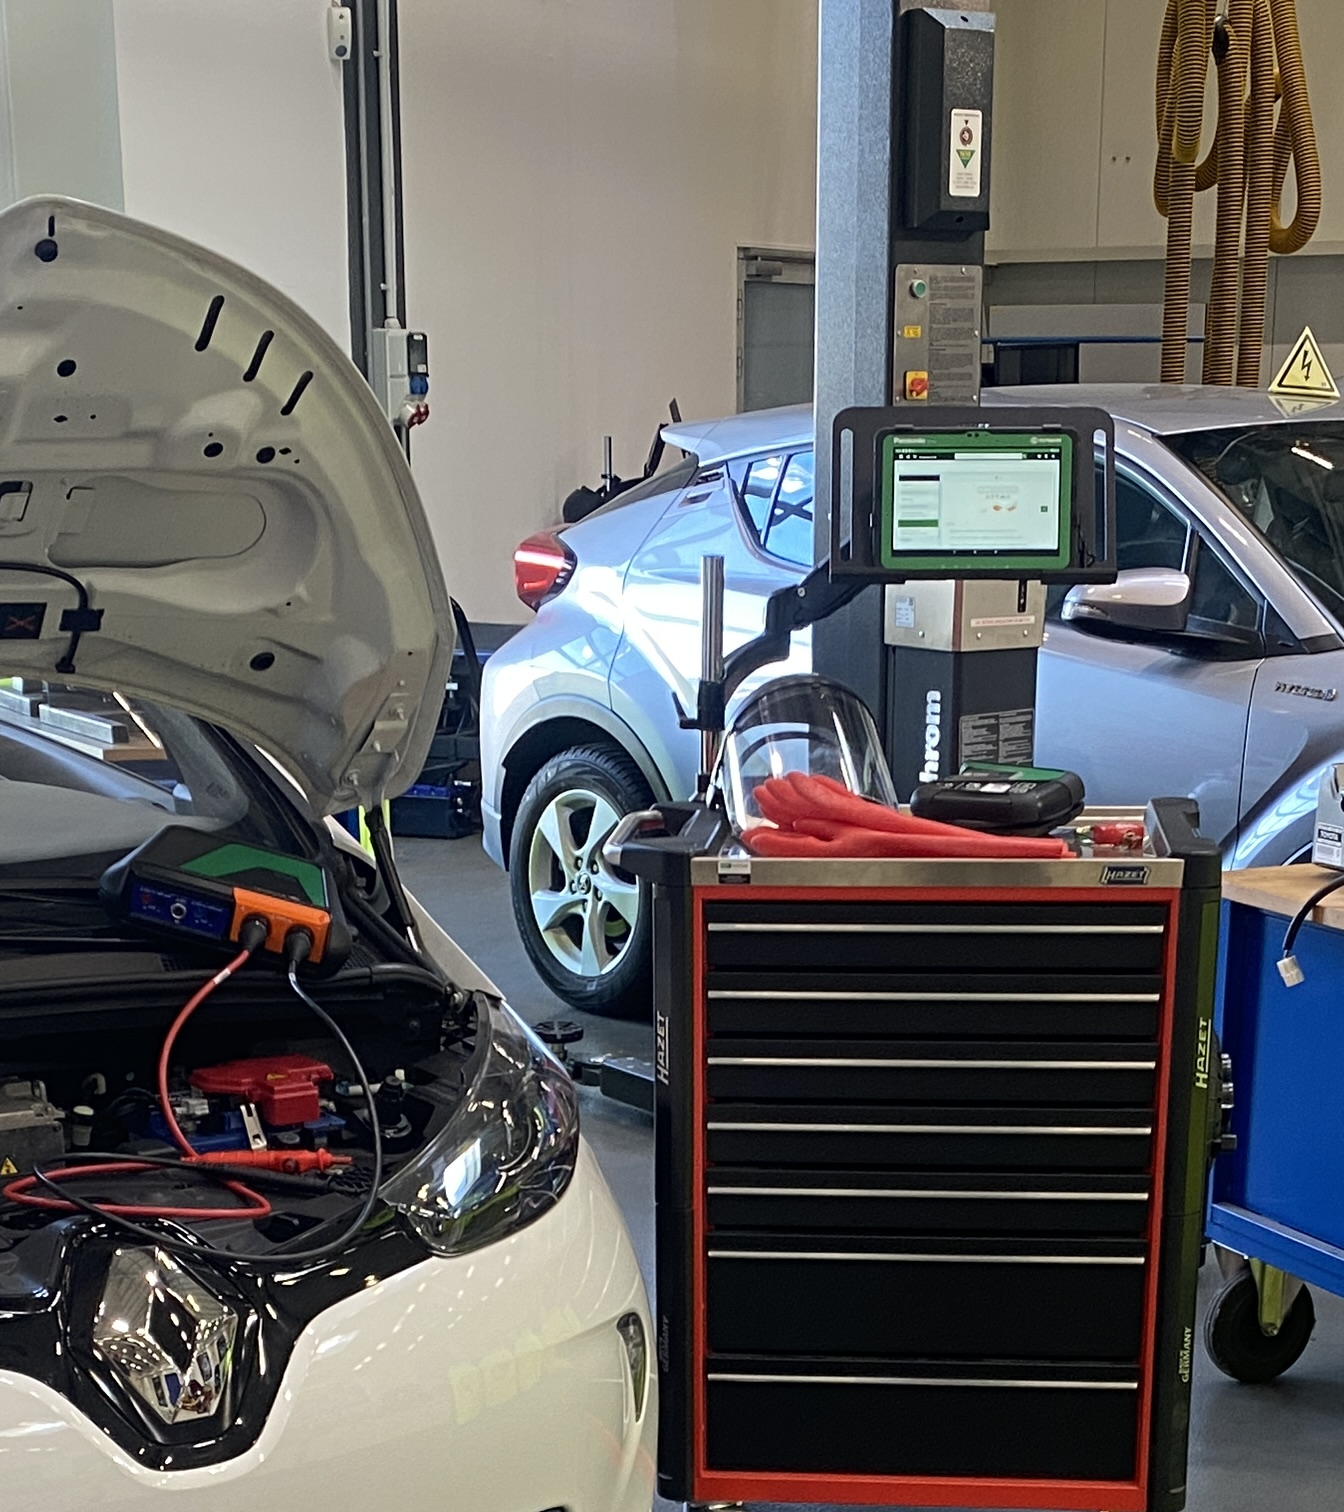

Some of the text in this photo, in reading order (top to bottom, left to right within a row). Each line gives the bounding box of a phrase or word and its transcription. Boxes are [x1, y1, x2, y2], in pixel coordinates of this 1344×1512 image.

[919, 690, 941, 784] hrom
[1106, 869, 1145, 881] HAZET
[656, 1010, 669, 1087] HAZET
[1196, 1016, 1209, 1090] HAZET
[1181, 1326, 1192, 1383] GERMANY
